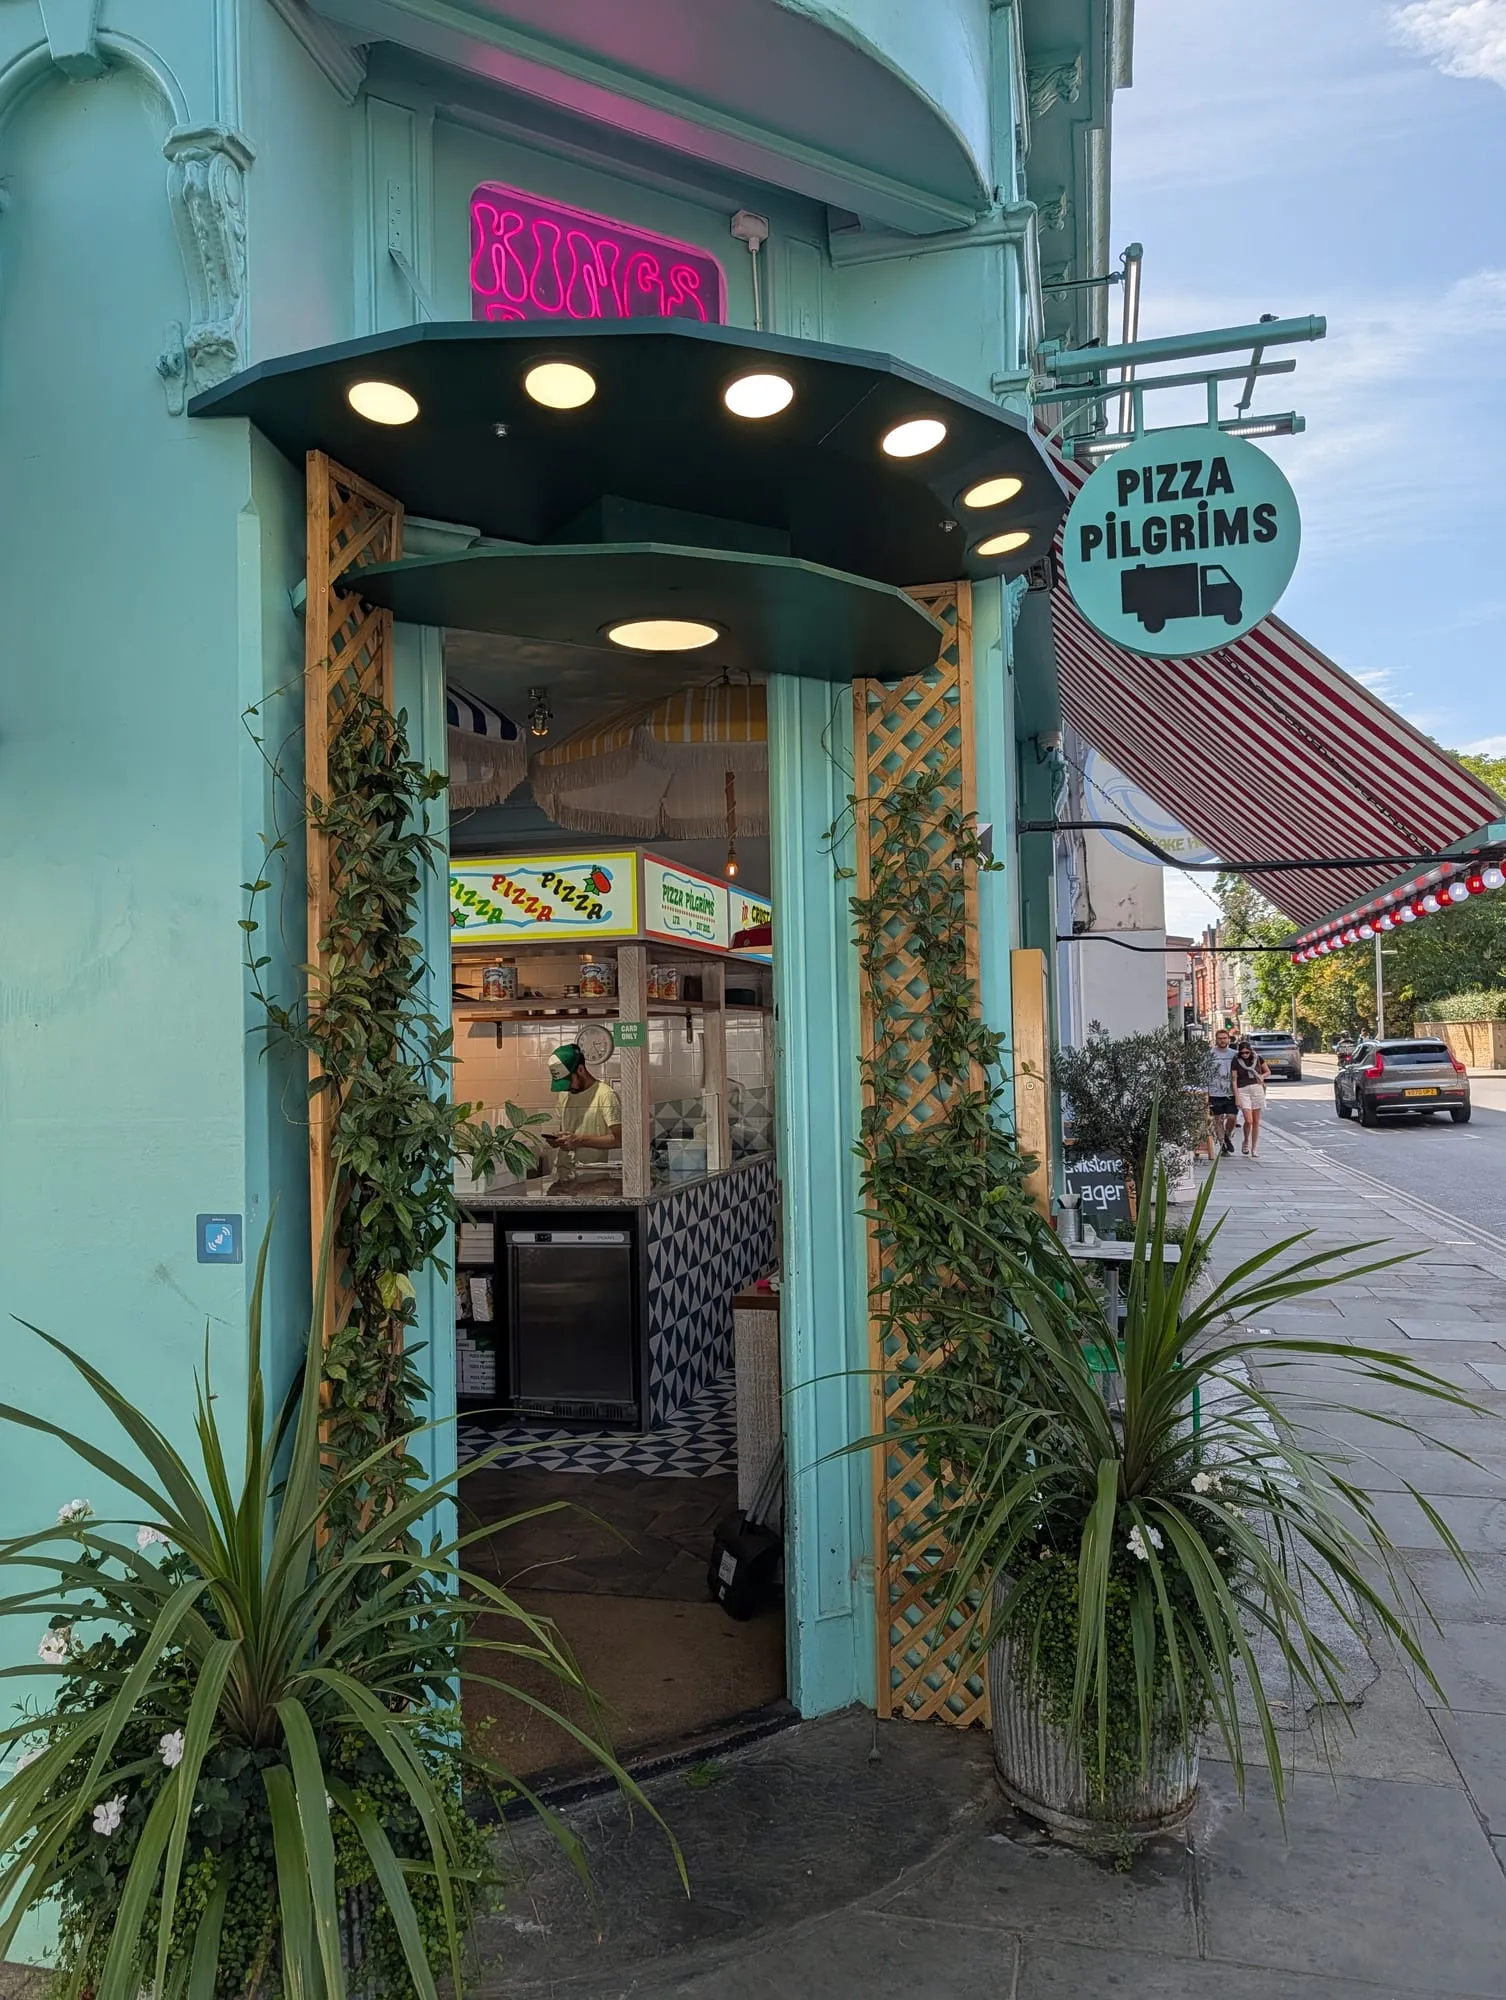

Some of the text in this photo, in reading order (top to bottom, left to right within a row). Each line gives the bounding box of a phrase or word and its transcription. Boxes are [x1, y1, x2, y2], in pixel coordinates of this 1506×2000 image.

[470, 202, 707, 322] KINGS
[1117, 457, 1235, 507] PIZZA
[491, 874, 553, 922] PIZZA
[541, 872, 603, 920] PIZZA
[662, 884, 683, 908] PIZZA
